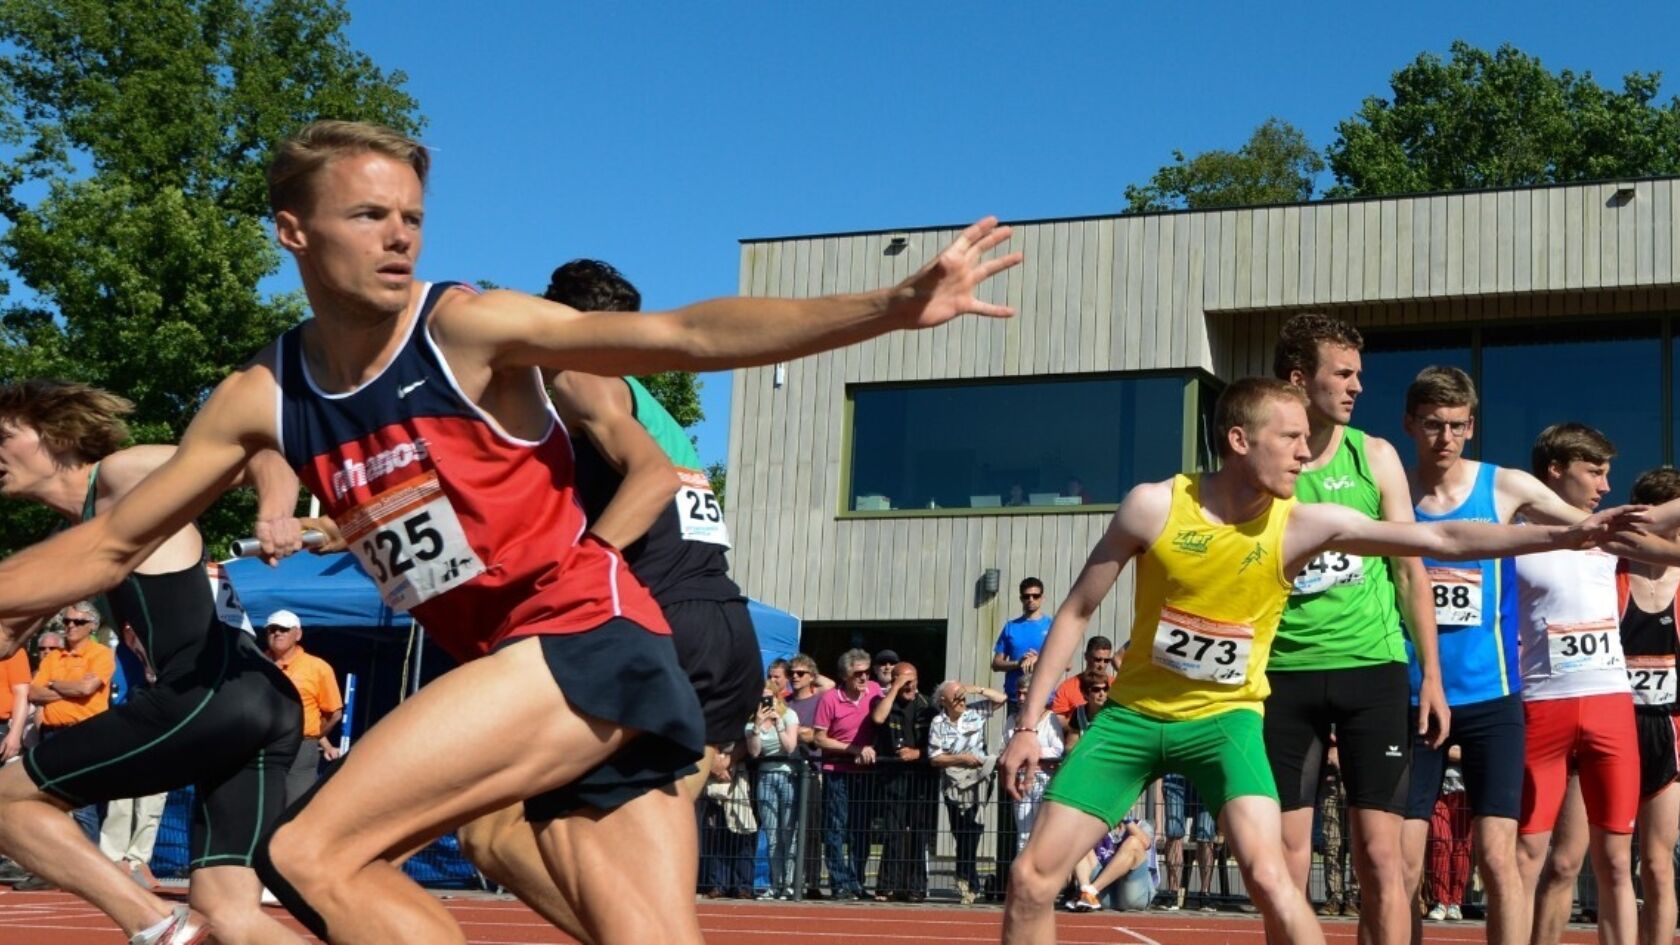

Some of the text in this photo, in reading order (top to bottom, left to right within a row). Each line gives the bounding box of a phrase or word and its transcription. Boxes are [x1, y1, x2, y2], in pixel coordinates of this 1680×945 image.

[686, 490, 720, 524] 25
[362, 511, 444, 584] 325
[1298, 551, 1350, 577] 43
[1165, 629, 1237, 666] 273
[1560, 632, 1610, 657] 301
